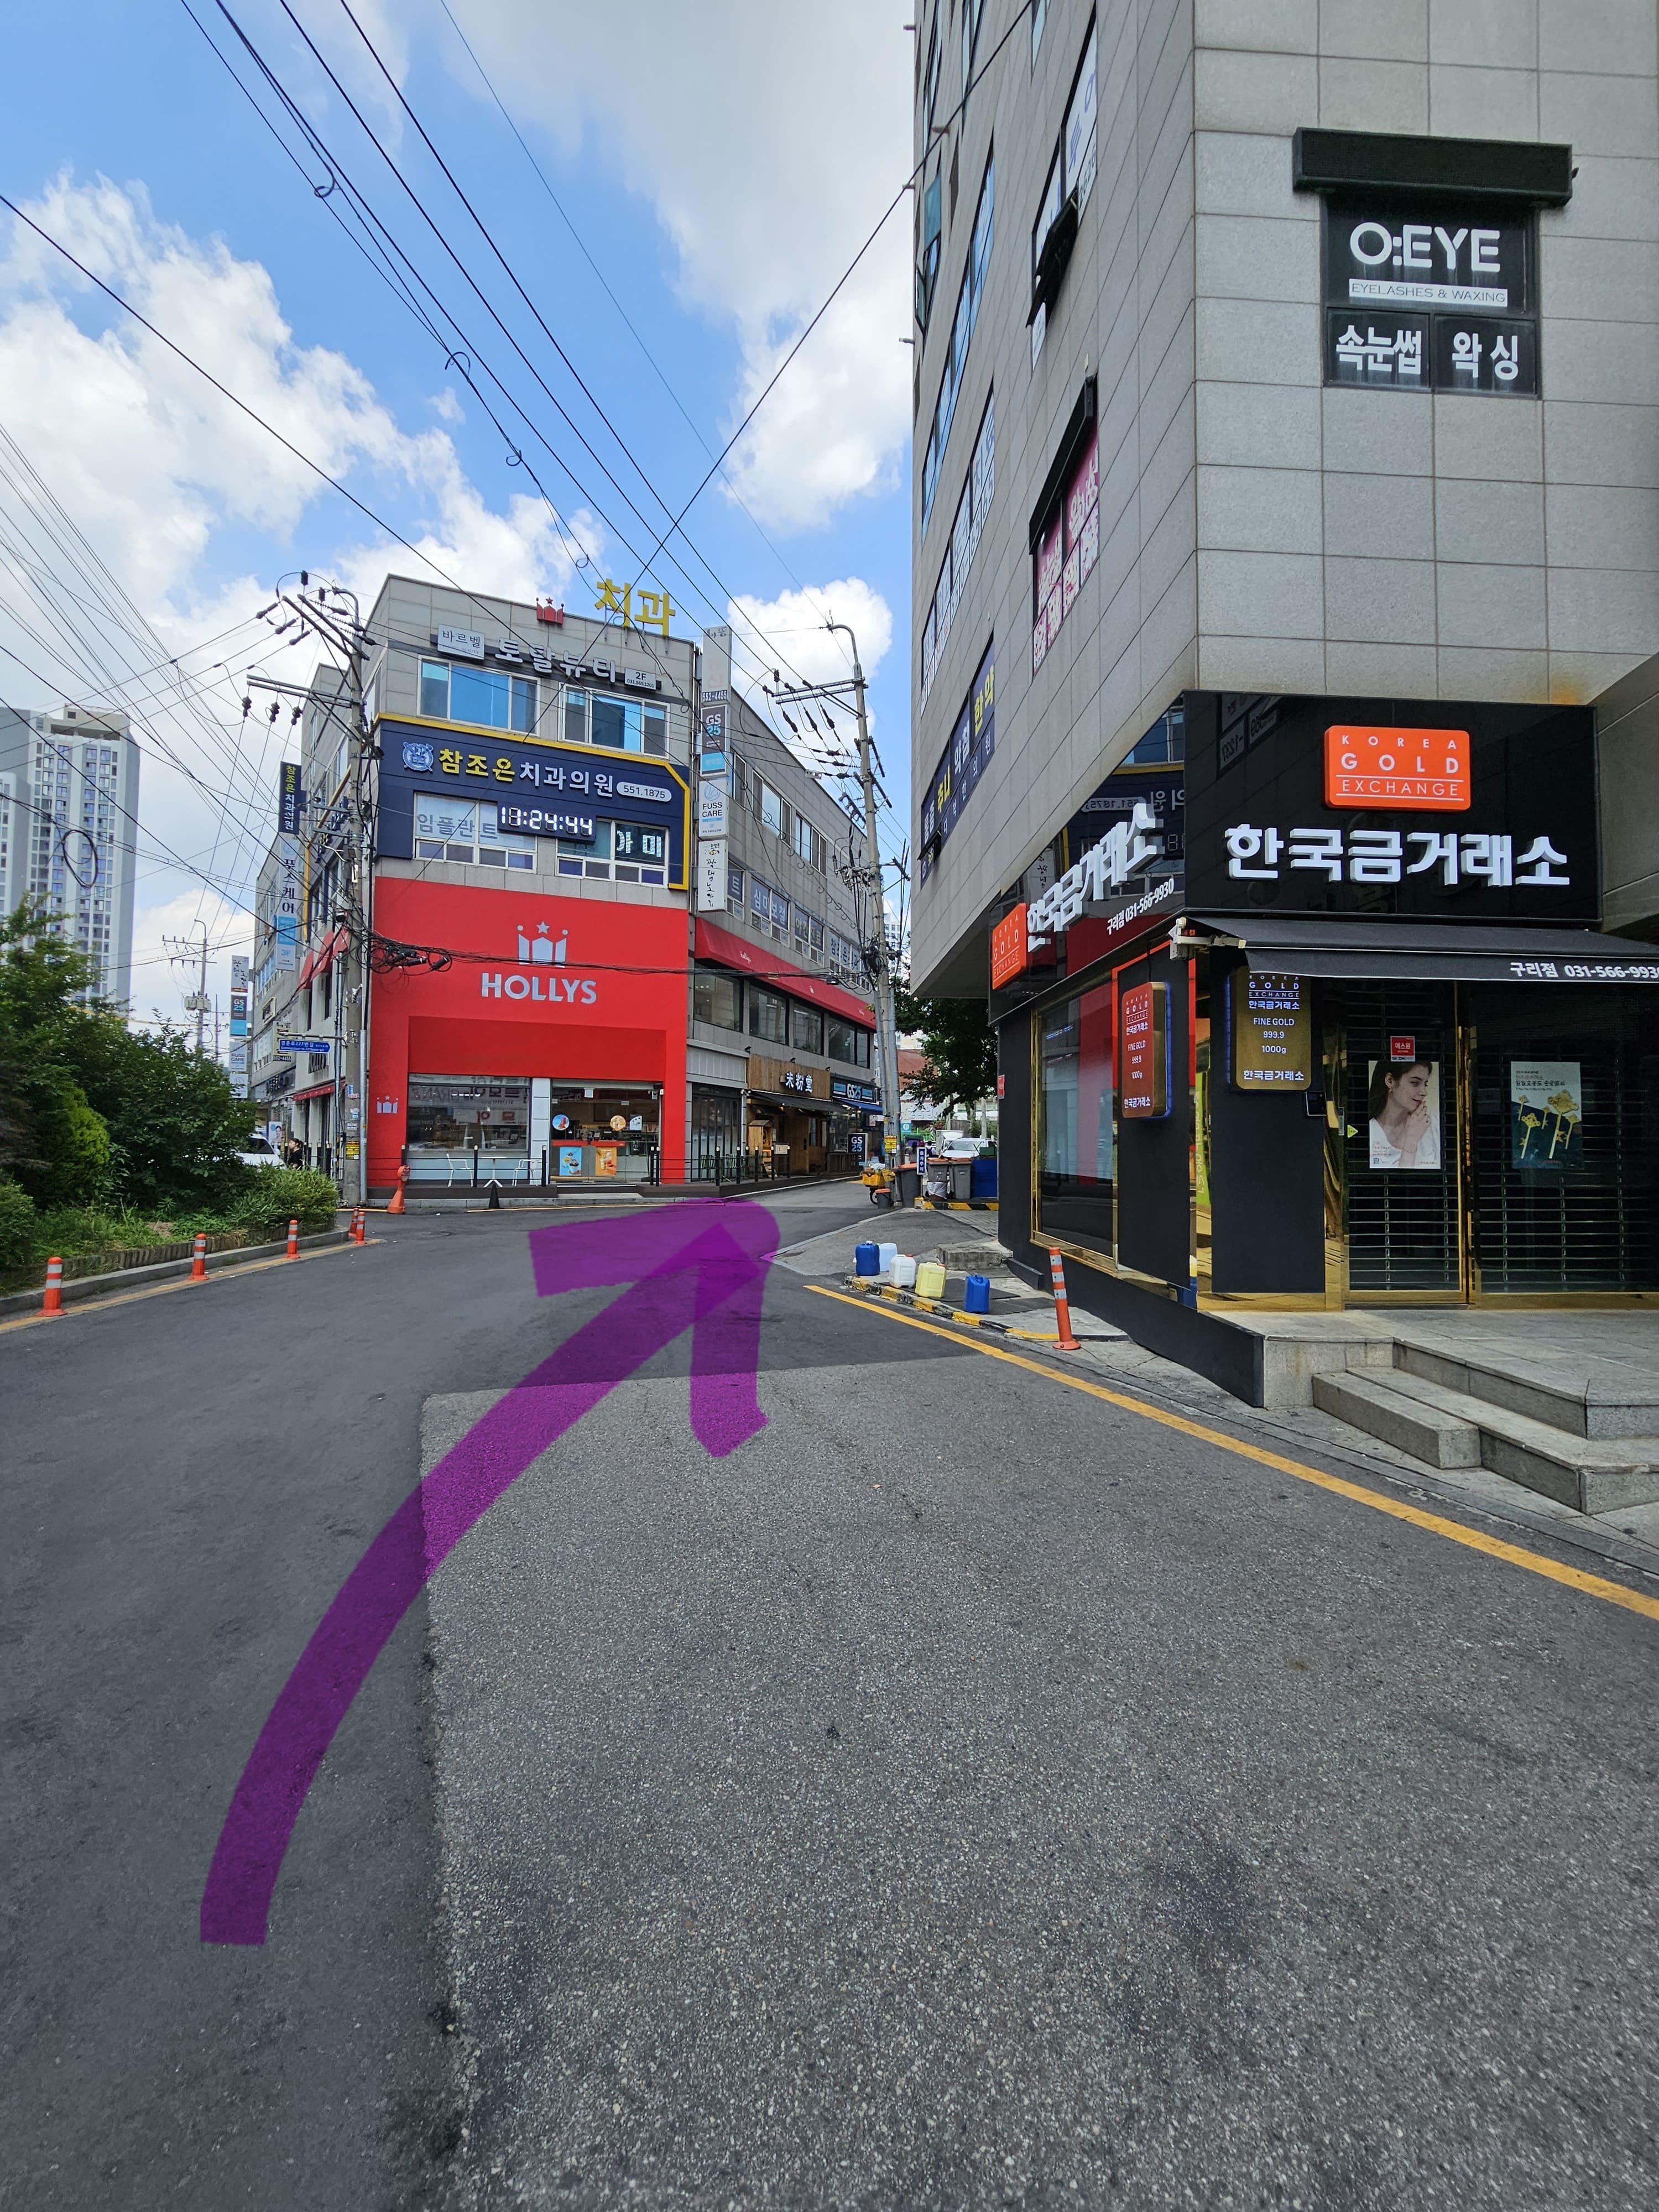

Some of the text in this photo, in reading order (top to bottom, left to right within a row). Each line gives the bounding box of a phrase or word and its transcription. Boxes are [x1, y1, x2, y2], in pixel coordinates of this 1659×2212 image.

[1350, 222, 1500, 272] O:EYE
[1352, 283, 1506, 303] EYELASHES & WAXING
[1336, 325, 1422, 375] 속눈썹
[1452, 332, 1519, 380] 왁싱
[594, 578, 676, 636] 치과
[442, 630, 480, 648] 바르벨
[495, 638, 615, 683] 토탈뷰티
[627, 679, 654, 688] 031.565.1201
[636, 672, 646, 681] 2F
[703, 691, 727, 702] 552-4455
[706, 714, 721, 726] GS
[706, 724, 721, 736] 25
[1342, 735, 1457, 749] KOREA
[924, 800, 934, 844] 통증
[974, 664, 994, 738] 한약
[1341, 753, 1458, 774] GOLD
[623, 784, 665, 799] 551.1875
[1343, 780, 1458, 796] EXCHANGE
[417, 814, 498, 839] 임플란트
[501, 806, 592, 836] 13:24:44
[1224, 823, 1569, 886] 한국금거래소
[283, 859, 296, 914] 푸스케어
[1027, 804, 1157, 952] 한국금거래소
[1107, 878, 1174, 935] 구리점 031-566-9930
[995, 929, 1018, 960] GOLD
[1510, 962, 1558, 977] 구리점
[481, 972, 597, 1004] HOLLYS
[1126, 1000, 1148, 1014] GOLD
[1249, 1000, 1300, 1010] 한국금거래소
[1126, 1022, 1149, 1035] 한국금거래소
[1253, 1018, 1271, 1026] FINE
[1128, 1040, 1146, 1051] FINE GOLD
[1261, 1045, 1286, 1054] 1000g
[786, 1072, 812, 1093] 米粉堂
[1243, 1070, 1304, 1081] 한국금거래소
[847, 1083, 861, 1099] GS25
[1124, 1097, 1150, 1109] 한국금거래소
